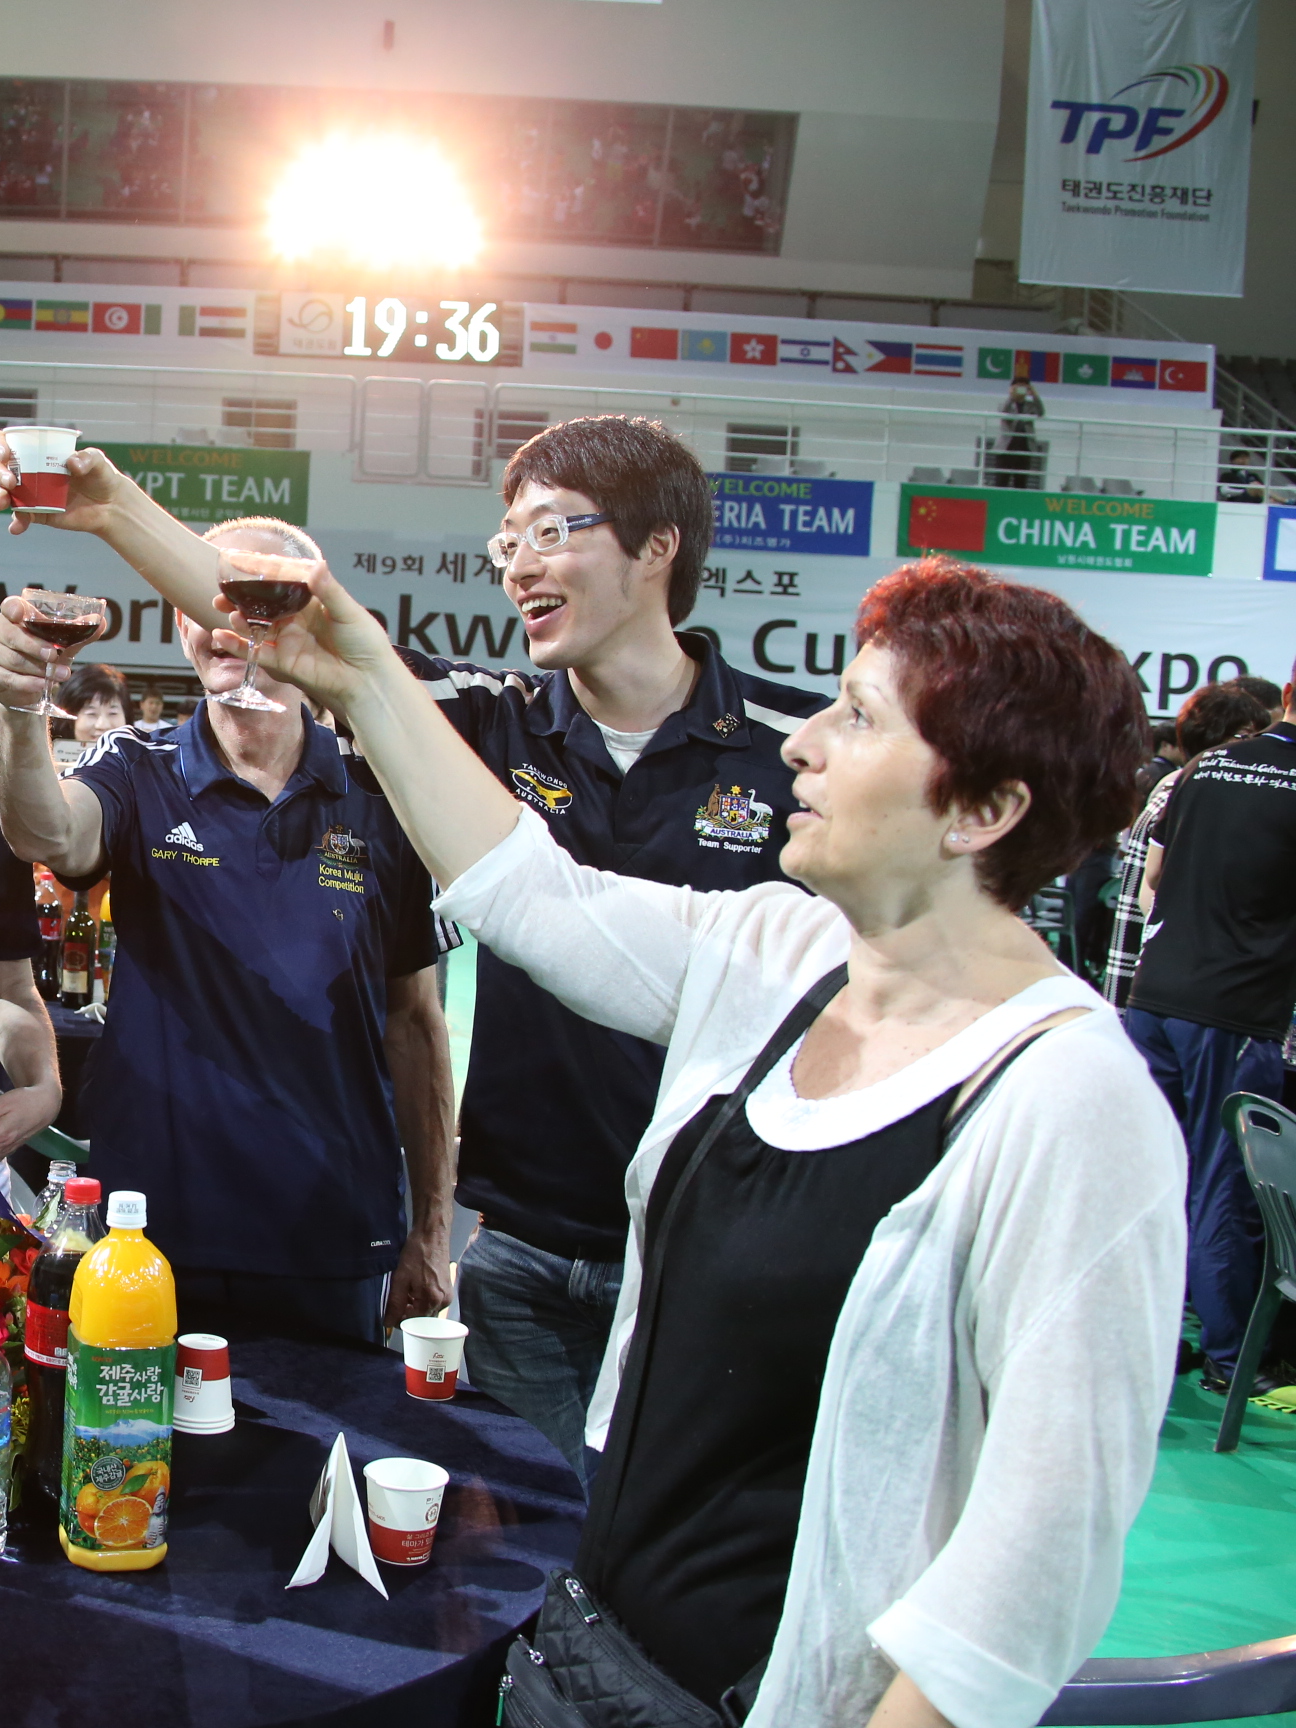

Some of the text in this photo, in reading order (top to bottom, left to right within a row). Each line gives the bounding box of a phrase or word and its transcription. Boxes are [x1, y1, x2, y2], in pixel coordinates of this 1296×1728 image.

[1050, 100, 1186, 155] TPF
[1061, 178, 1213, 208] 태권도진흥재단
[343, 296, 500, 362] 19:36
[129, 448, 245, 469] WELCOME
[199, 473, 292, 505] TEAM
[778, 503, 856, 535] TEAM
[1045, 497, 1155, 519] WELCOME
[997, 516, 1198, 556] CHINA TEAM
[353, 552, 424, 576] 제9회
[1132, 651, 1250, 710] xpo
[165, 832, 205, 853] adidas
[710, 828, 754, 839] AUSTRALIA
[151, 847, 221, 868] GARY THORPE
[697, 838, 763, 854] Team Supporter
[318, 862, 343, 878] Korea
[99, 1363, 162, 1383] 제주사랑
[95, 1382, 165, 1407] 감귤사랑
